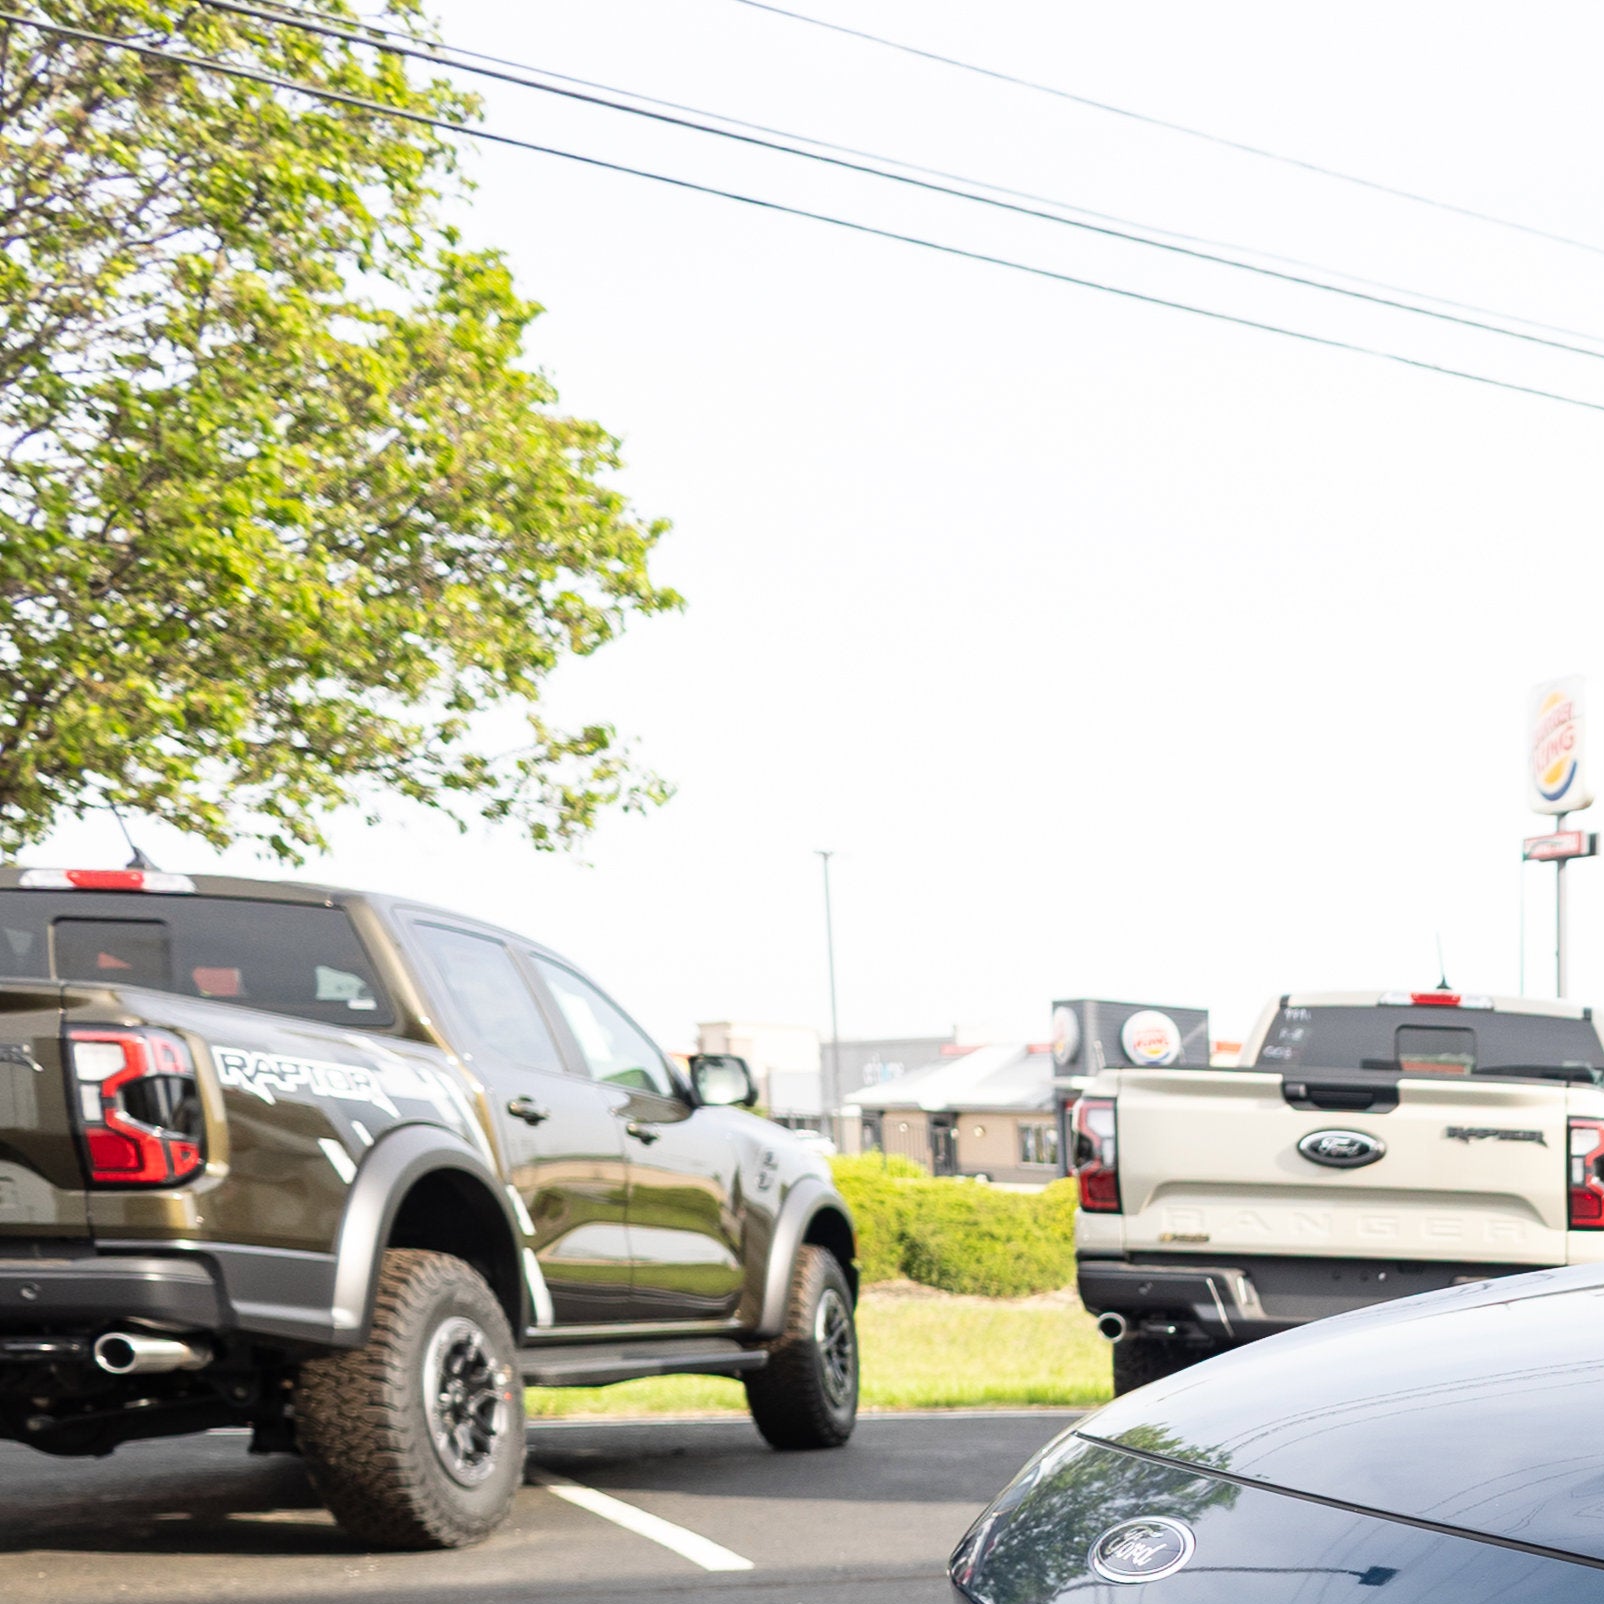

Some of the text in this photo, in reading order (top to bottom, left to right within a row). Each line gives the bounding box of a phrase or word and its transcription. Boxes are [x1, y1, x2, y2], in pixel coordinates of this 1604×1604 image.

[211, 1045, 400, 1119] RAPTOR
[1161, 1205, 1529, 1245] RANGER
[1104, 1525, 1168, 1567] Ford
